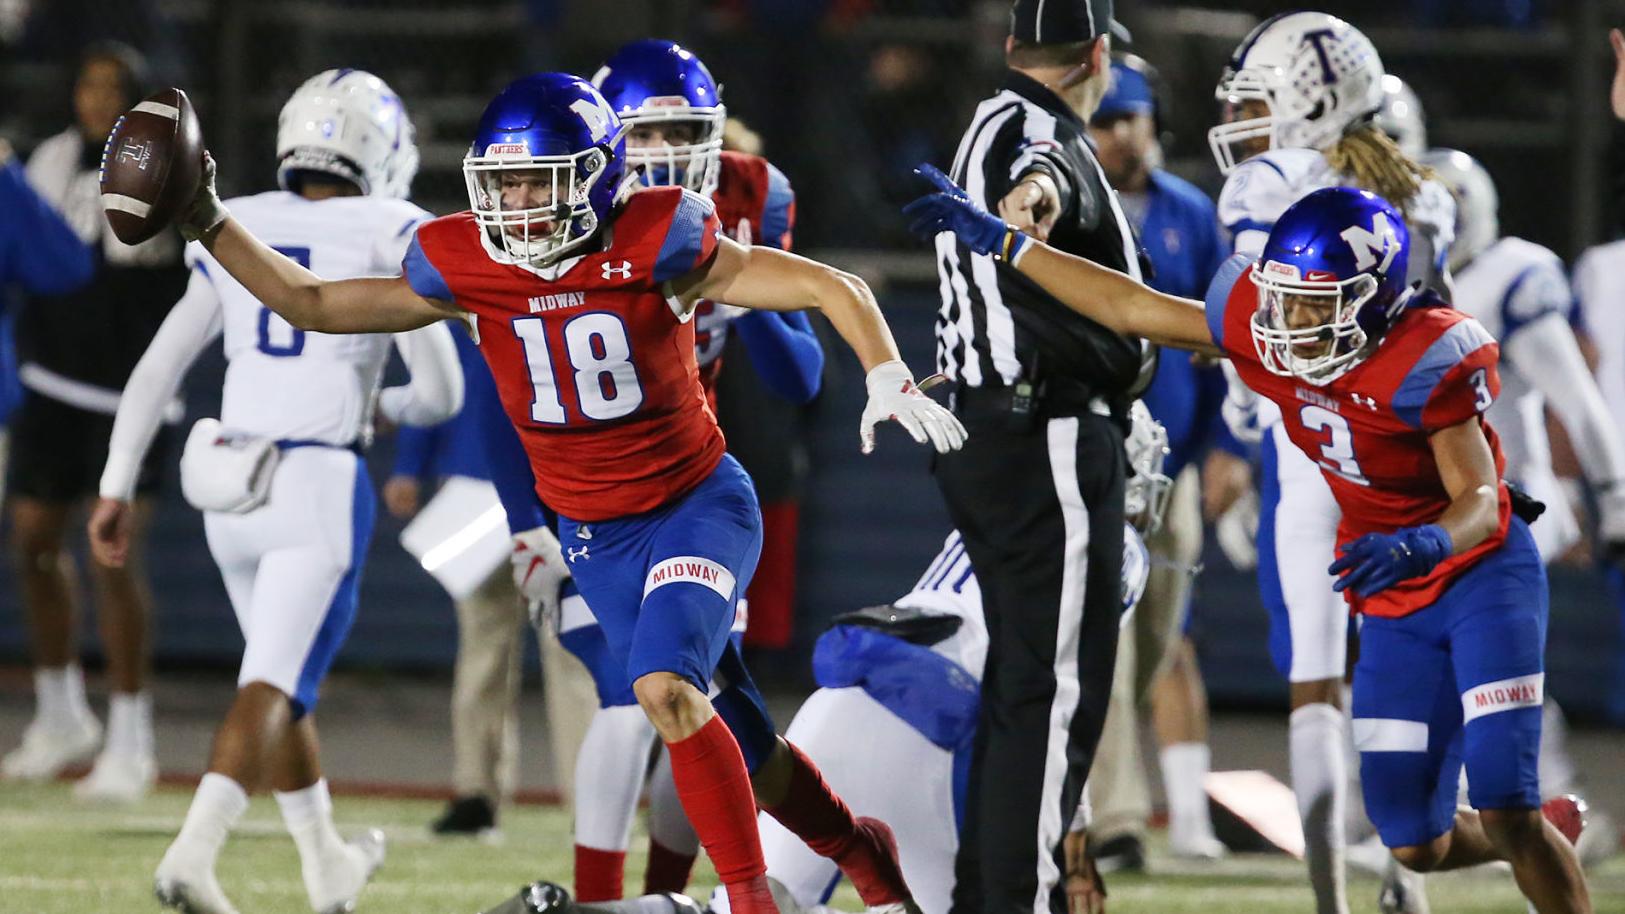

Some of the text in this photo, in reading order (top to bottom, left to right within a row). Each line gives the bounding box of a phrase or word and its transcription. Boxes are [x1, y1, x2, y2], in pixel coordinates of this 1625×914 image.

[1303, 28, 1341, 86] T
[1339, 210, 1399, 273] M
[528, 291, 586, 314] MIDWAY
[512, 310, 644, 425] 18
[1469, 367, 1495, 413] 3
[1299, 403, 1371, 486] 3
[653, 563, 719, 584] MIDWAY
[1475, 684, 1536, 708] MIDWAY
